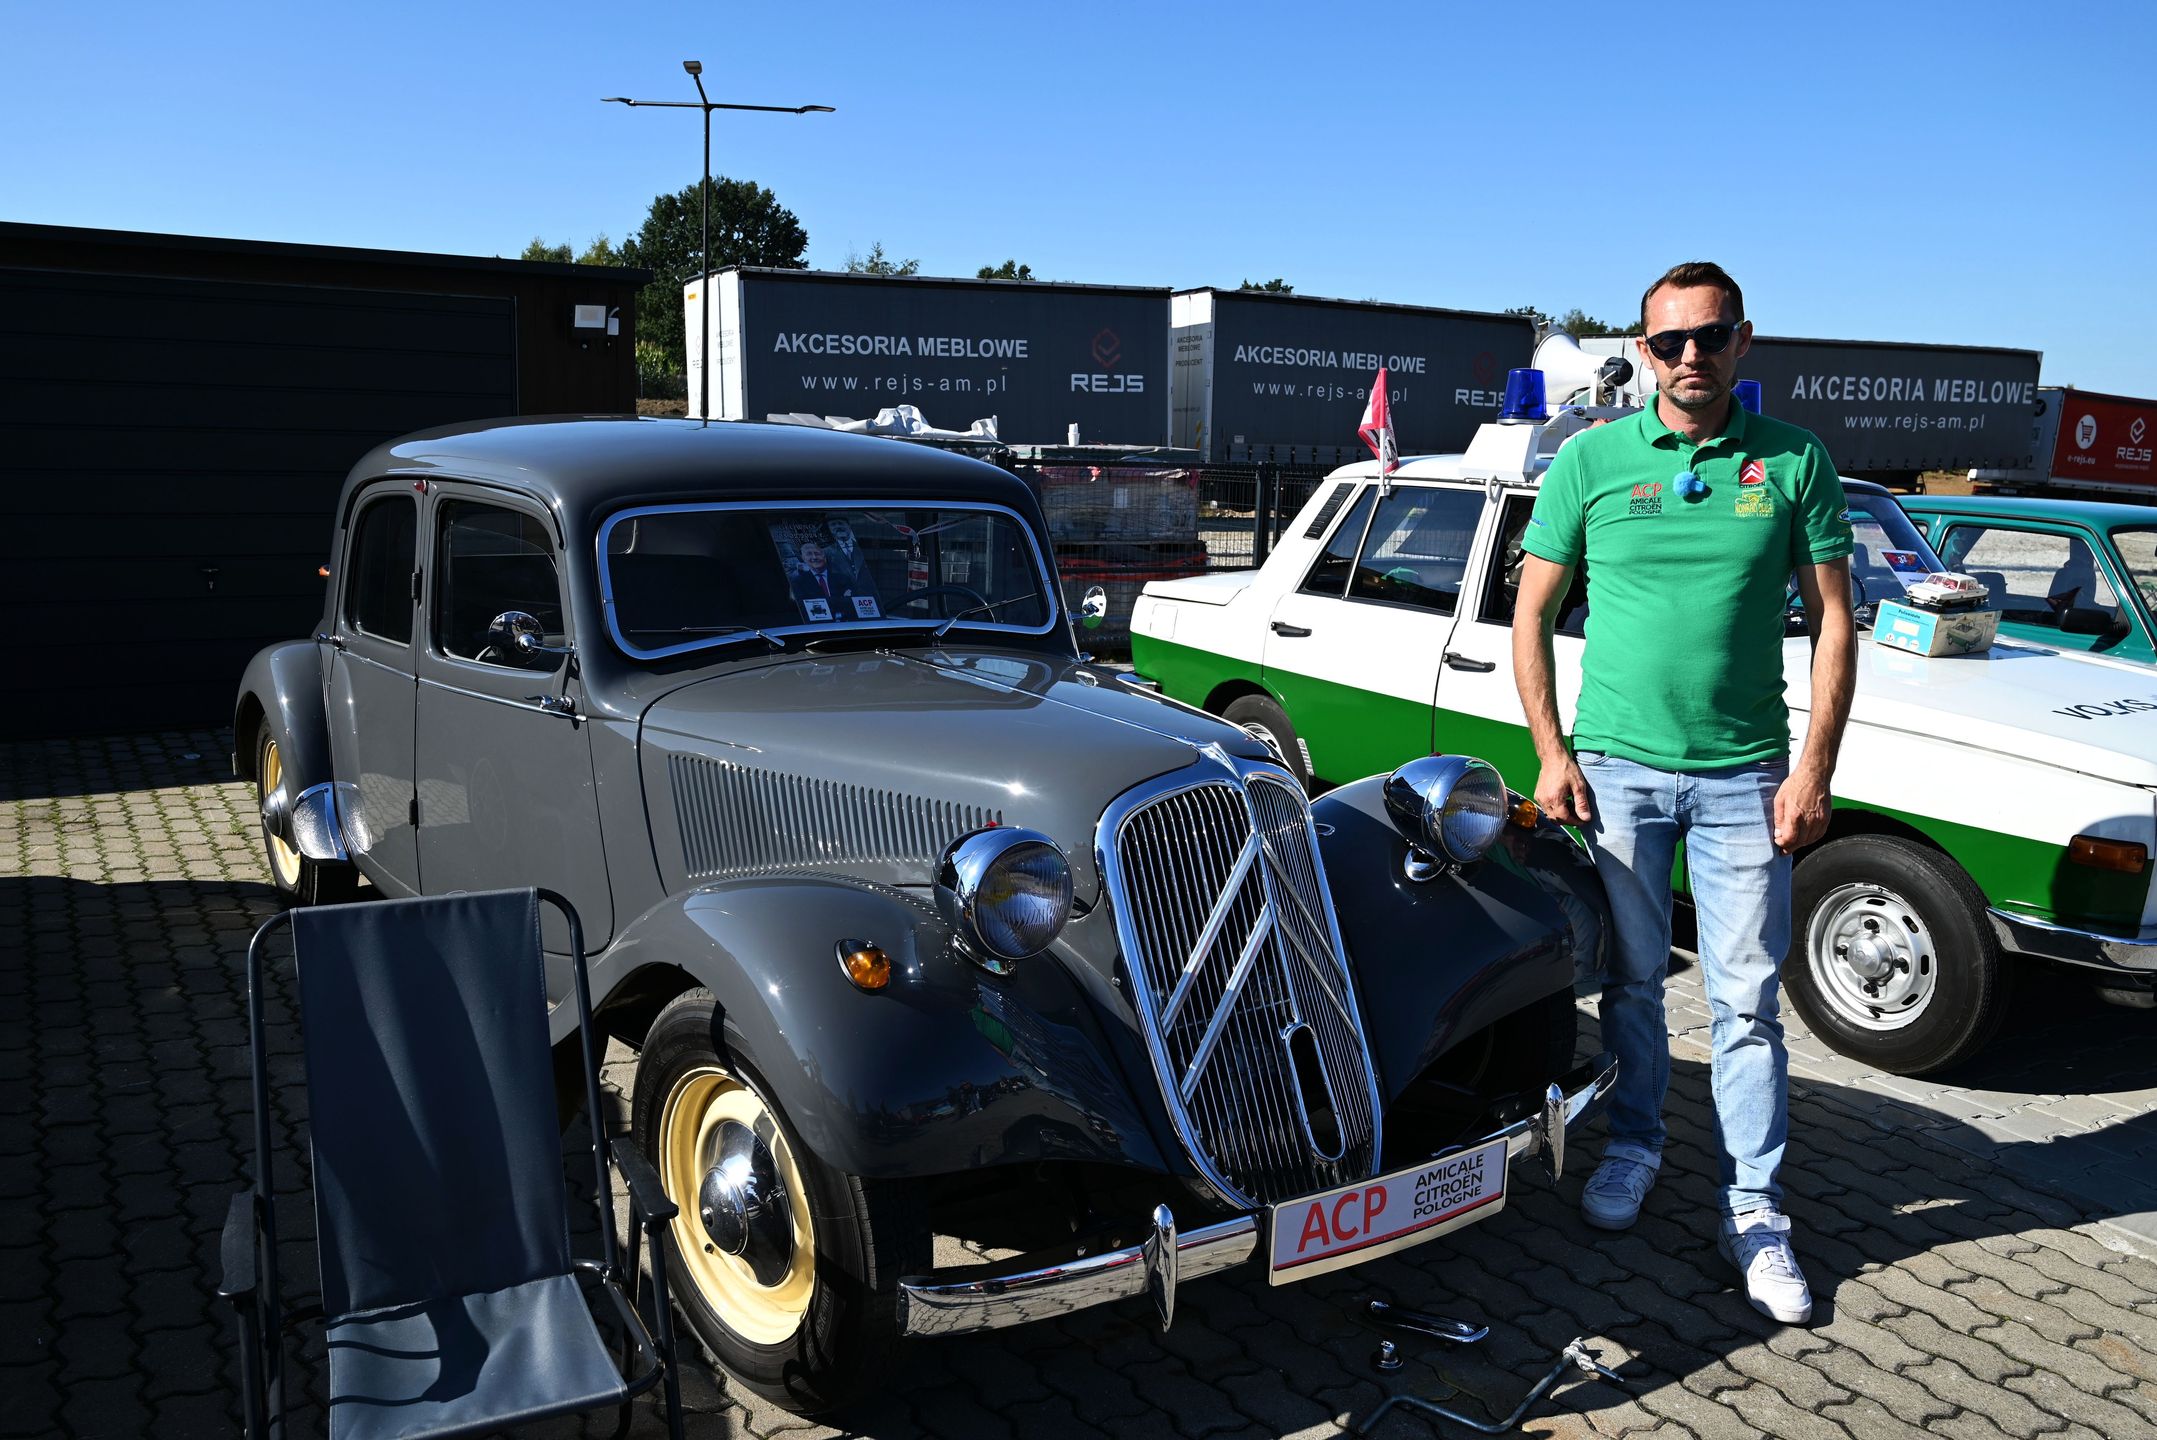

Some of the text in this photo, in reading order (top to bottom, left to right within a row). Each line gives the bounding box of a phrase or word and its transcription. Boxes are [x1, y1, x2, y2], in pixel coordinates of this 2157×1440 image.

[774, 332, 1028, 360] AKCESORIA MEBLOWE
[1234, 344, 1426, 374] AKCESORIA MEBLOWE
[802, 373, 1007, 395] www.rejs-am.pl
[1071, 373, 1144, 393] REJS
[1253, 380, 1408, 406] www.rejs-apl
[1791, 375, 2034, 405] AKCESORIA MEBLOWE
[1844, 411, 1985, 432] www.rejs-am.pl
[2067, 454, 2096, 465] e-rejs.eu
[2116, 446, 2152, 462] REJS
[1631, 482, 1663, 498] ACP
[2051, 698, 2157, 720] VOLKS
[1415, 1153, 1485, 1190] AMICALE
[1414, 1169, 1483, 1206] CITROËN
[1413, 1185, 1482, 1220] POLOGNE
[1297, 1184, 1388, 1253] ACP
